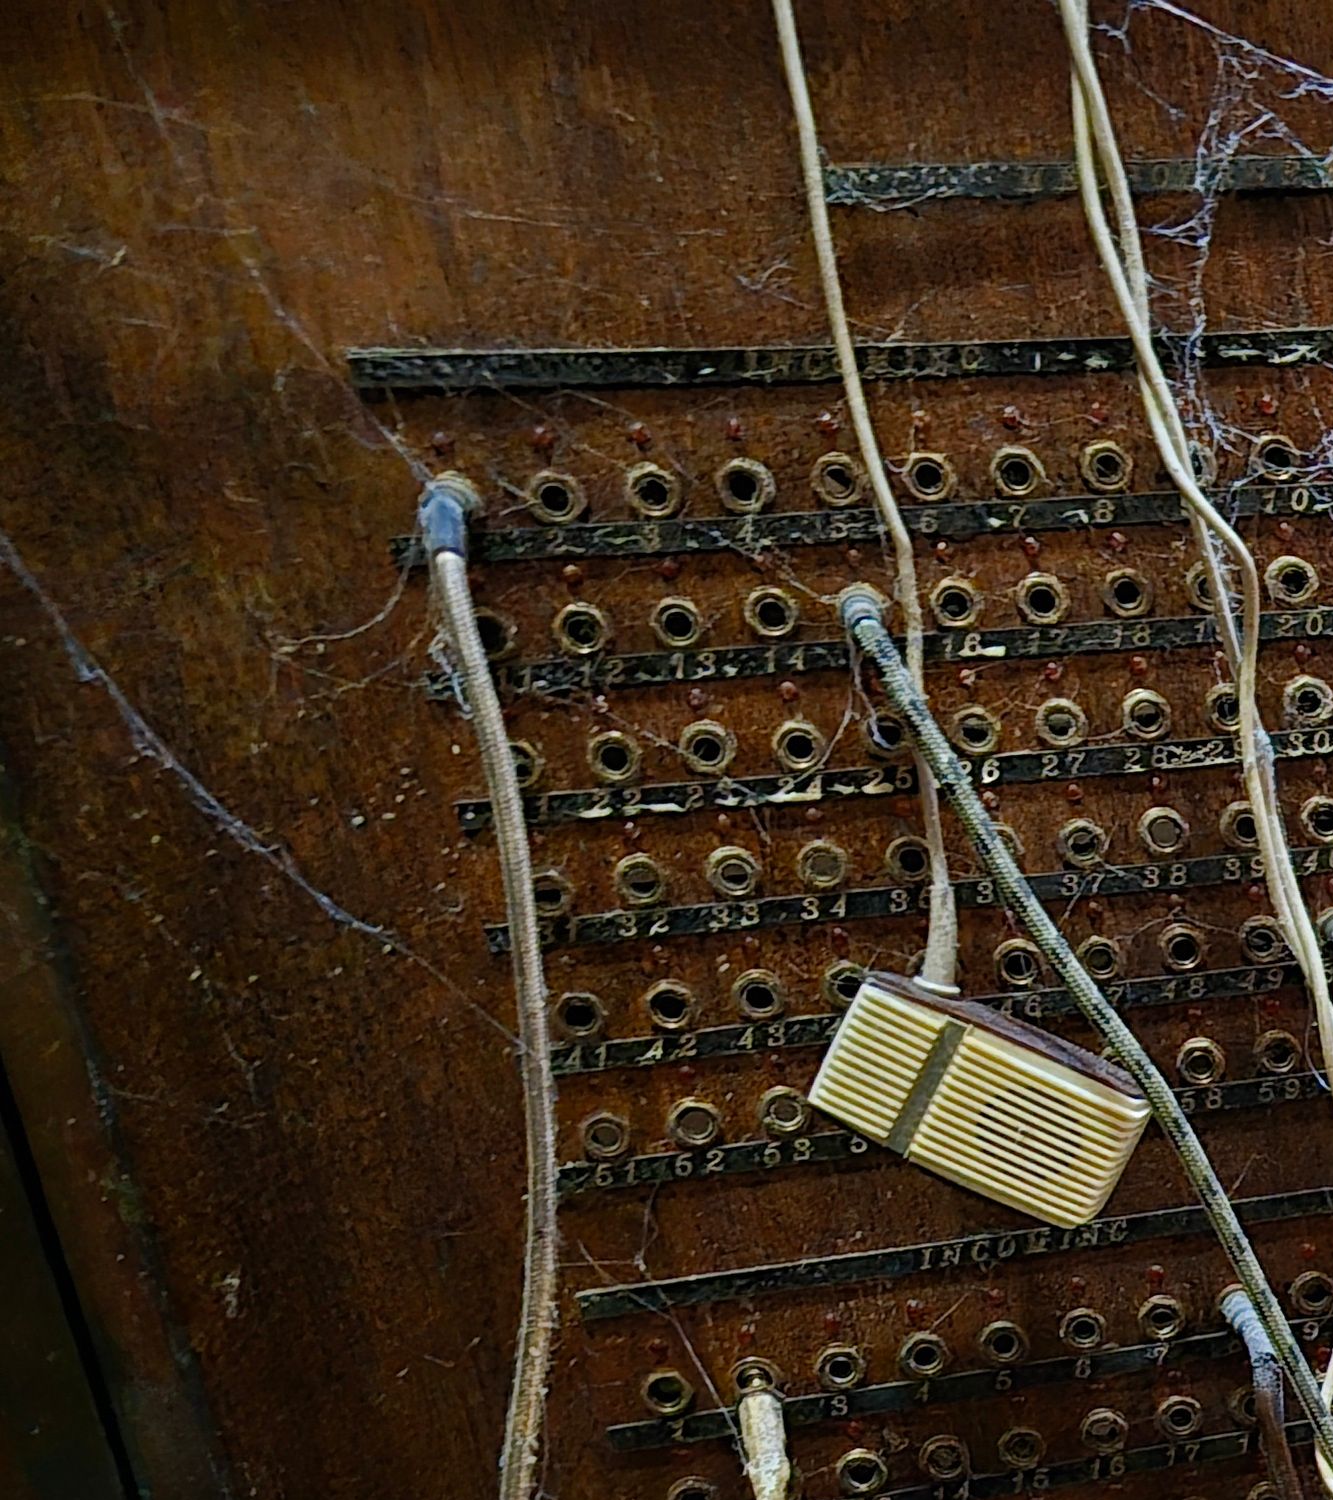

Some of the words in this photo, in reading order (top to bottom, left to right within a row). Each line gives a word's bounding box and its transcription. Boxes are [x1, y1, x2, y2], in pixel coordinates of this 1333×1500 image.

[1010, 506, 1026, 526] 7
[1098, 501, 1115, 521] 8
[1263, 488, 1309, 511] 10
[671, 653, 716, 677] 13
[766, 648, 803, 671] 14
[1030, 628, 1068, 652] 17
[1110, 624, 1151, 648] 18
[1277, 614, 1323, 636] 20
[865, 769, 912, 793] 25
[1041, 753, 1085, 777] 27
[1123, 747, 1166, 769] 28
[618, 911, 669, 935] 32
[709, 901, 759, 926] 33
[801, 899, 846, 920] 34
[1143, 865, 1188, 887] 38
[563, 1045, 608, 1069] 41
[645, 1037, 698, 1061] 42
[737, 1025, 786, 1050] 43
[1000, 995, 1042, 1017] 46
[1160, 974, 1207, 999] 48
[1240, 968, 1284, 991] 49
[595, 1161, 637, 1185] 51
[674, 1150, 725, 1175] 52
[763, 1139, 814, 1165] 53
[1257, 1078, 1298, 1100] 59
[1155, 1344, 1169, 1366] 7
[1303, 1321, 1319, 1341] 9
[1090, 1456, 1126, 1481] 16
